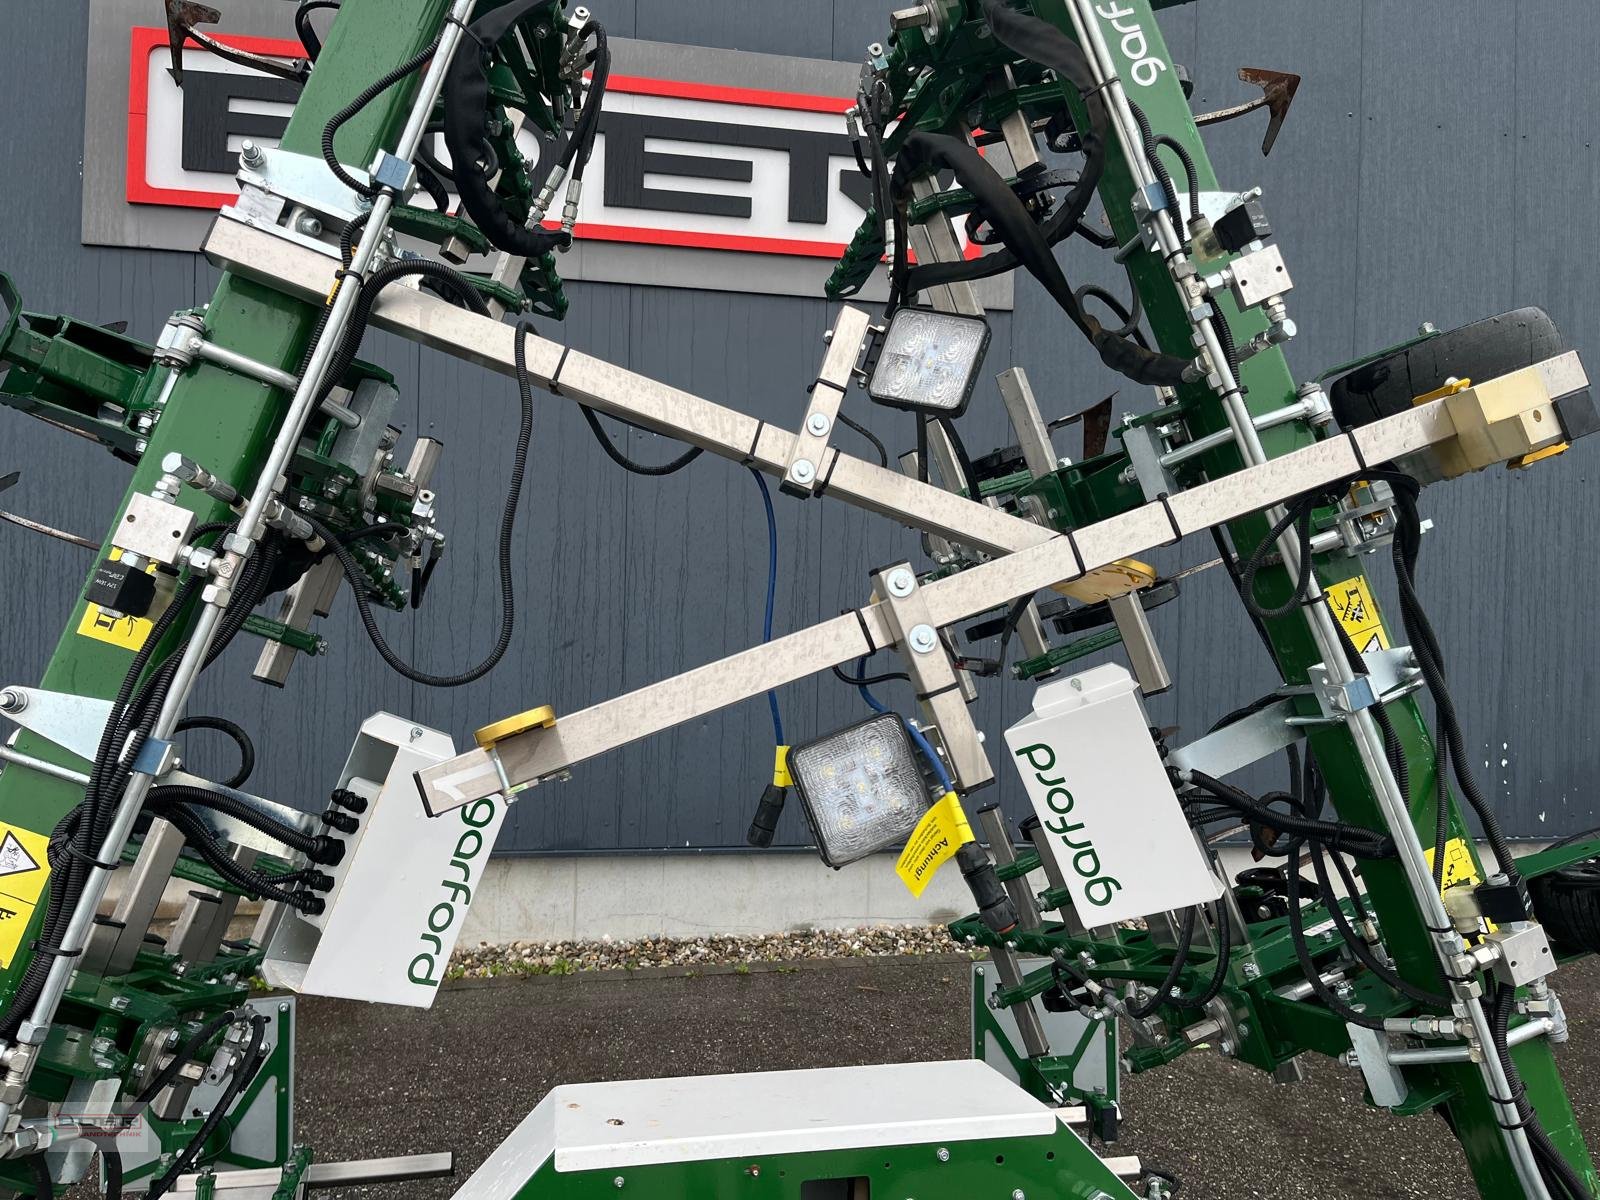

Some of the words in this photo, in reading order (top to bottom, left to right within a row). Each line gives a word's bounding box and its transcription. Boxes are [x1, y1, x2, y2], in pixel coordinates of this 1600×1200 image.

[407, 798, 495, 987] garford
[914, 837, 949, 881] Achtung!
[1014, 743, 1123, 907] garford
